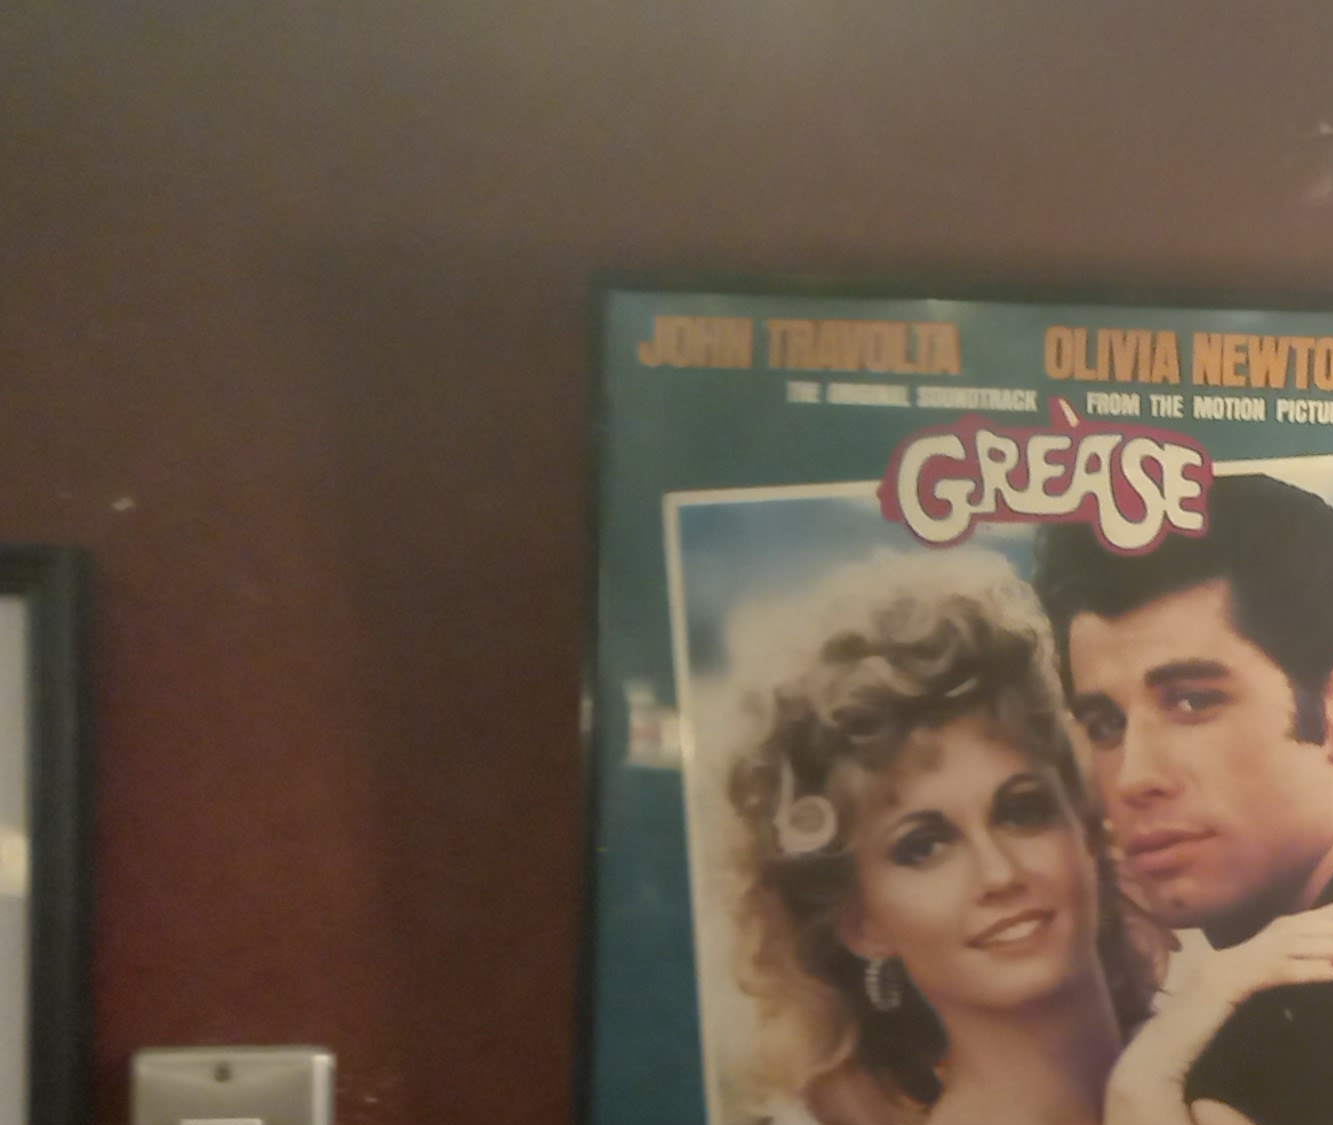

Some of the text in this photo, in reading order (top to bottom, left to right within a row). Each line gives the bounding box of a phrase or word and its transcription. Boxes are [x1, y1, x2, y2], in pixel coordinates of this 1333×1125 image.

[638, 315, 963, 375] JOHN TRAVOLTA
[1045, 325, 1180, 385] OLIVIA
[916, 386, 1038, 413] SOUNDTRACK
[1087, 391, 1141, 418] FROM
[1150, 394, 1184, 420] THE
[1193, 396, 1267, 423] MOTION
[897, 428, 1205, 552] GREASE
